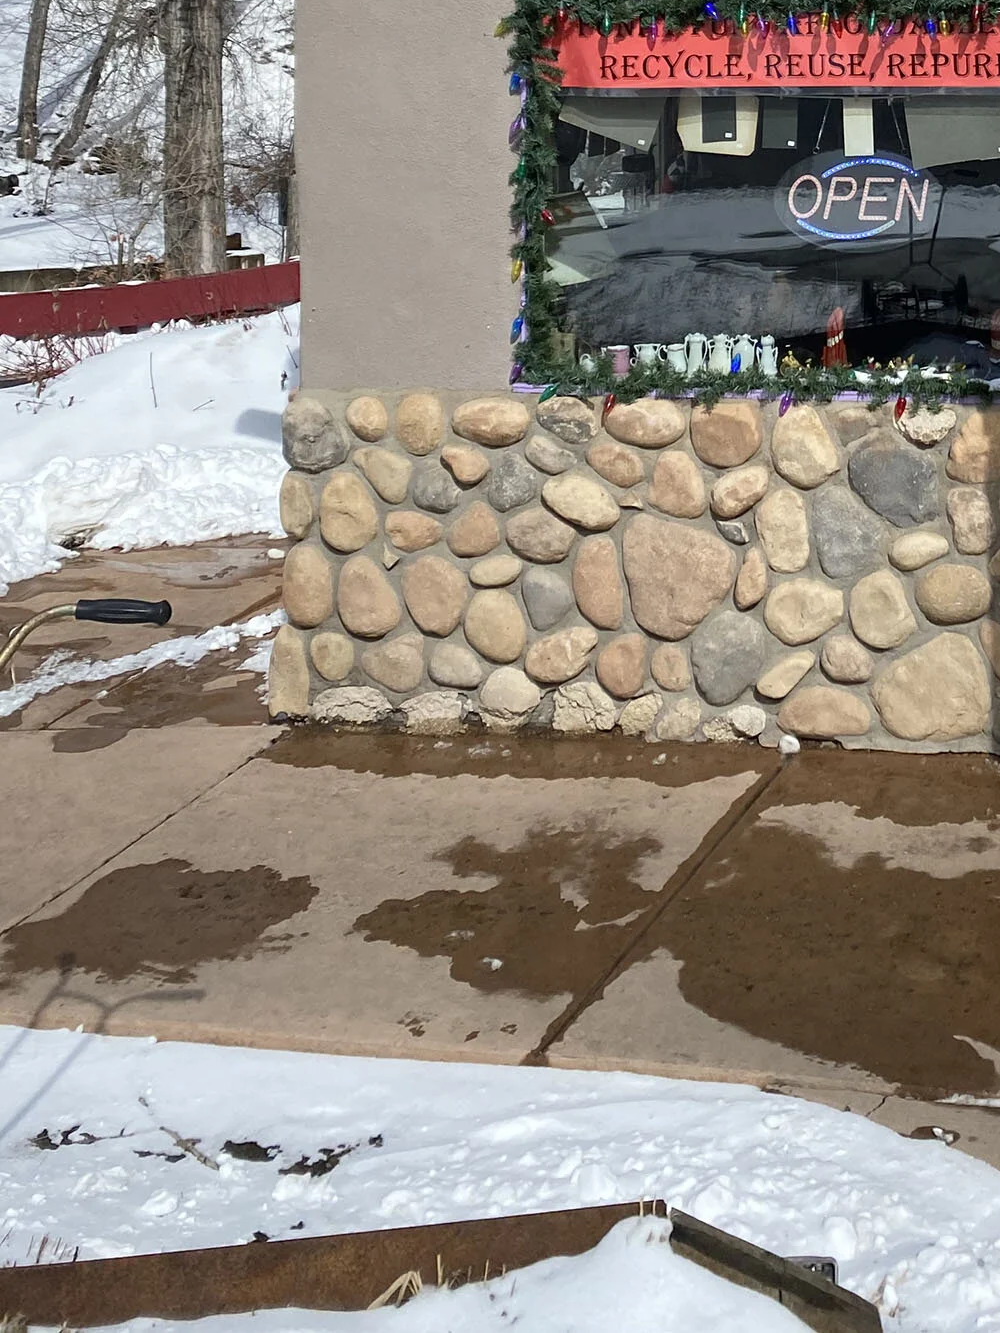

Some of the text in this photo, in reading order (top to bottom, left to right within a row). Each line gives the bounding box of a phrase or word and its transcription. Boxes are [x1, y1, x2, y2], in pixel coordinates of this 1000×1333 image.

[600, 50, 753, 81] RECYCLE,
[764, 53, 875, 82] REUSE,
[788, 174, 929, 222] OPEN
